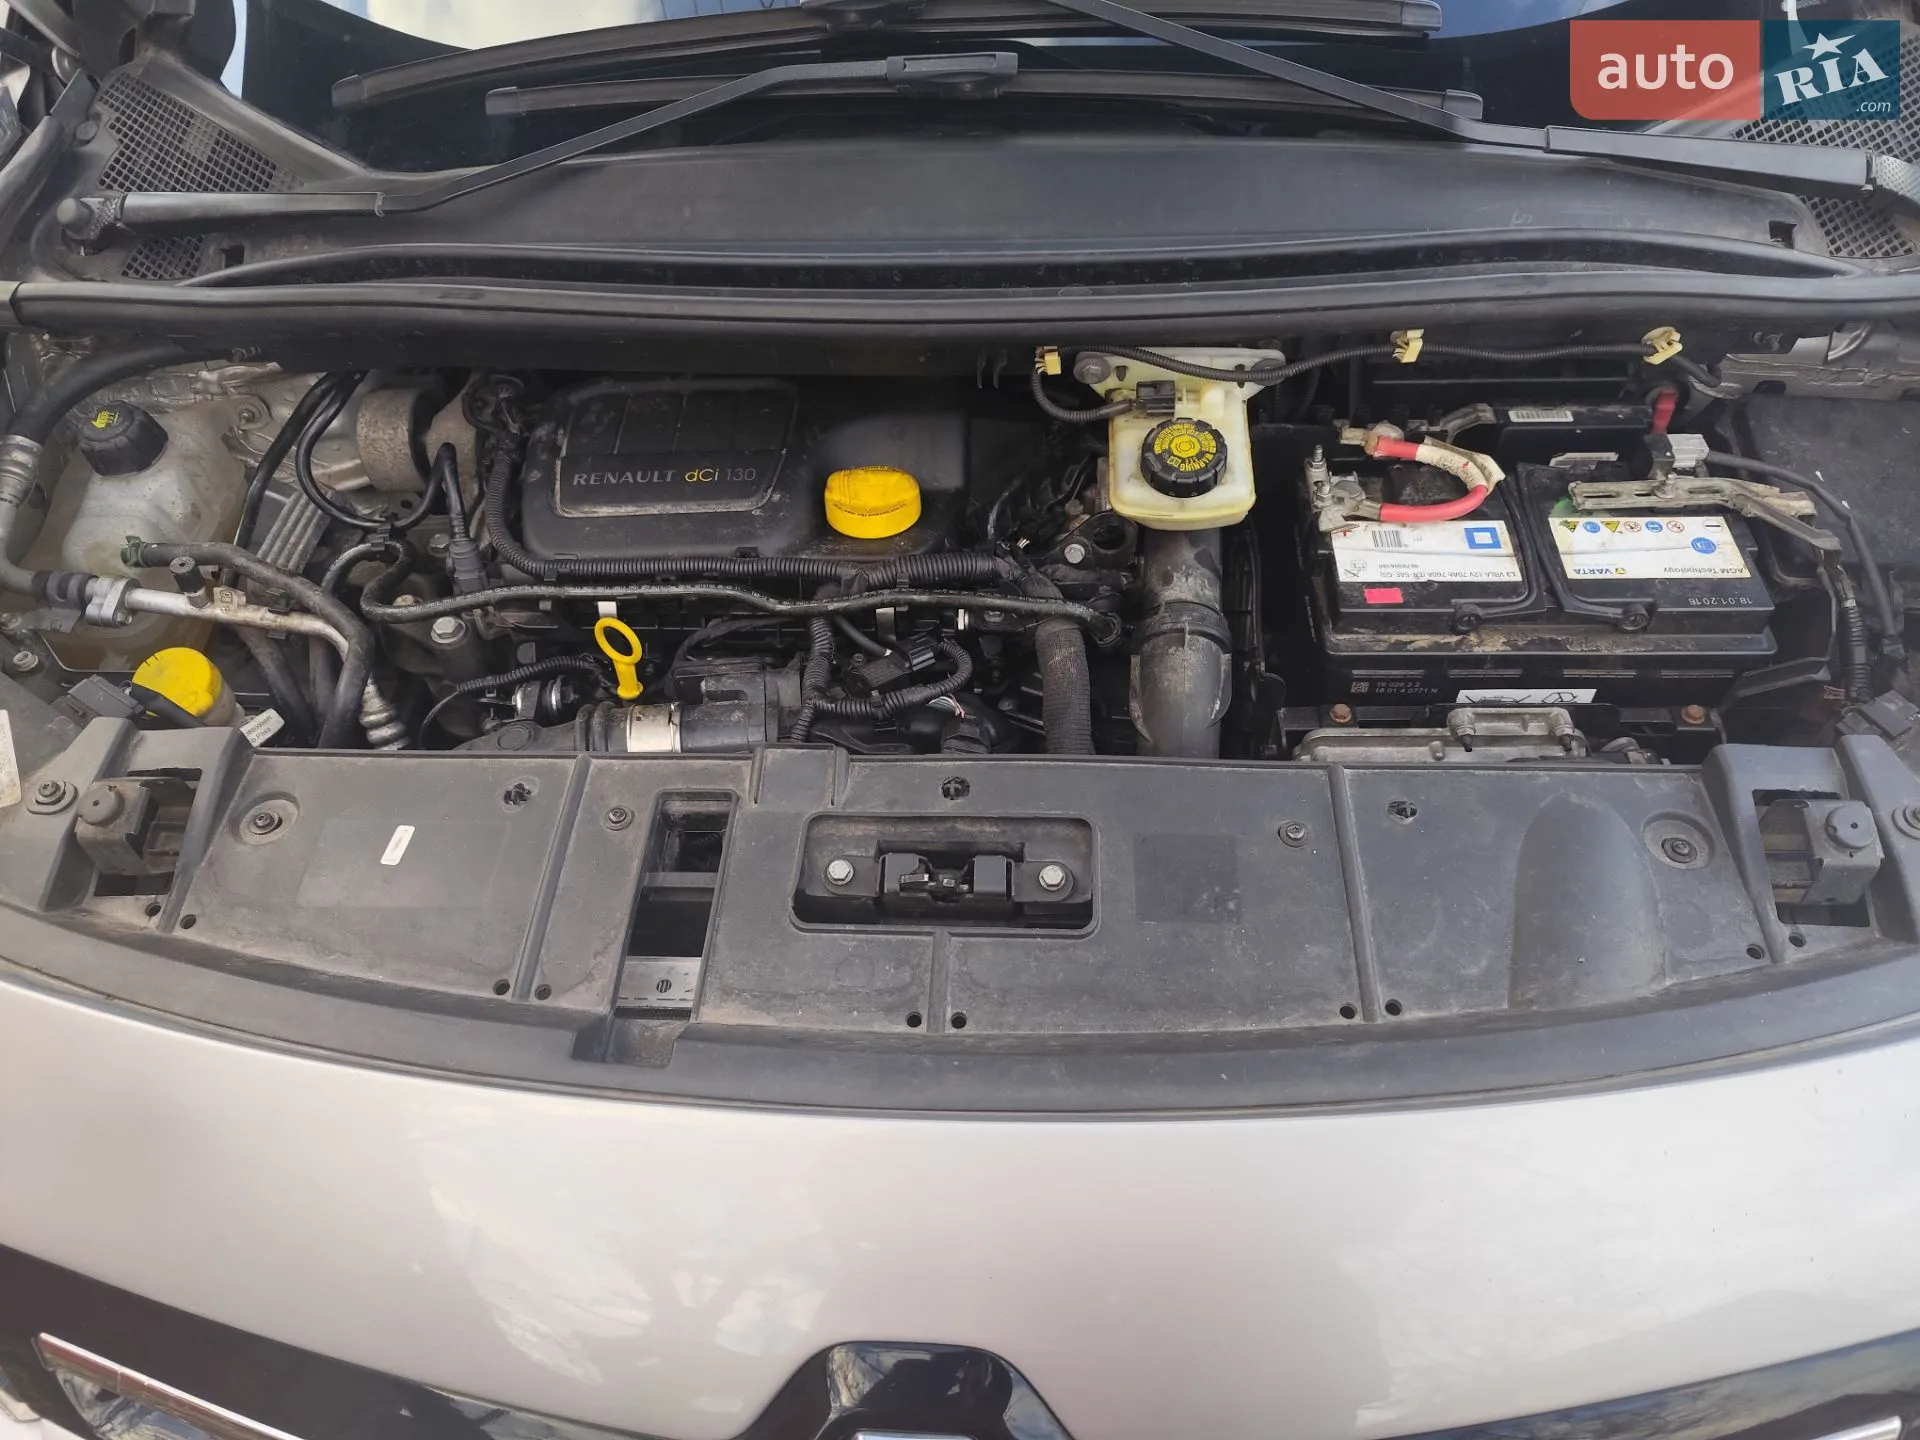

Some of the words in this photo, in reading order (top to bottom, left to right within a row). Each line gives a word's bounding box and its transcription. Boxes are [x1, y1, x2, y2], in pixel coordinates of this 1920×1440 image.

[1179, 453, 1215, 472] WARNING
[573, 469, 678, 486] RENAULT
[684, 468, 720, 482] dCi
[725, 467, 756, 481] 130
[1663, 566, 1719, 574] Technology
